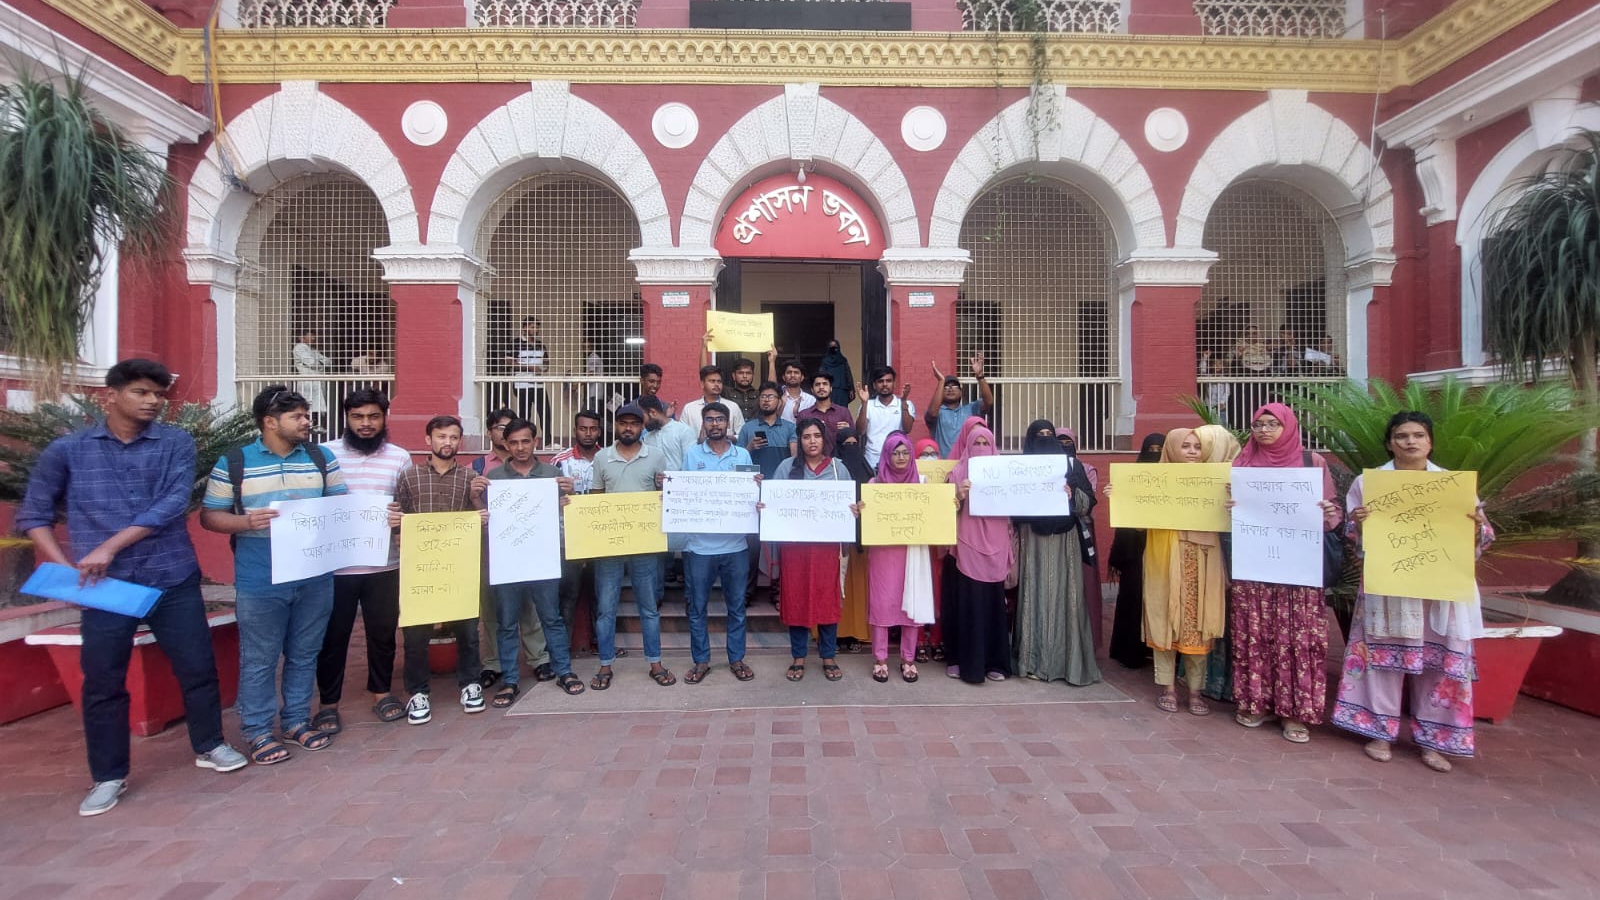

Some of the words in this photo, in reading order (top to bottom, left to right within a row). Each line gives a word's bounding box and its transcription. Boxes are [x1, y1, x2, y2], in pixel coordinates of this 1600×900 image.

[732, 185, 814, 244] প্রশাসন
[822, 189, 870, 246] ভবন
[982, 465, 1000, 480] NU
[1246, 481, 1286, 492] আমার
[1287, 481, 1314, 495] বাবা
[1267, 502, 1302, 514] কৃষক
[292, 511, 329, 530] শিক্ষা
[1232, 518, 1272, 538] টাকার
